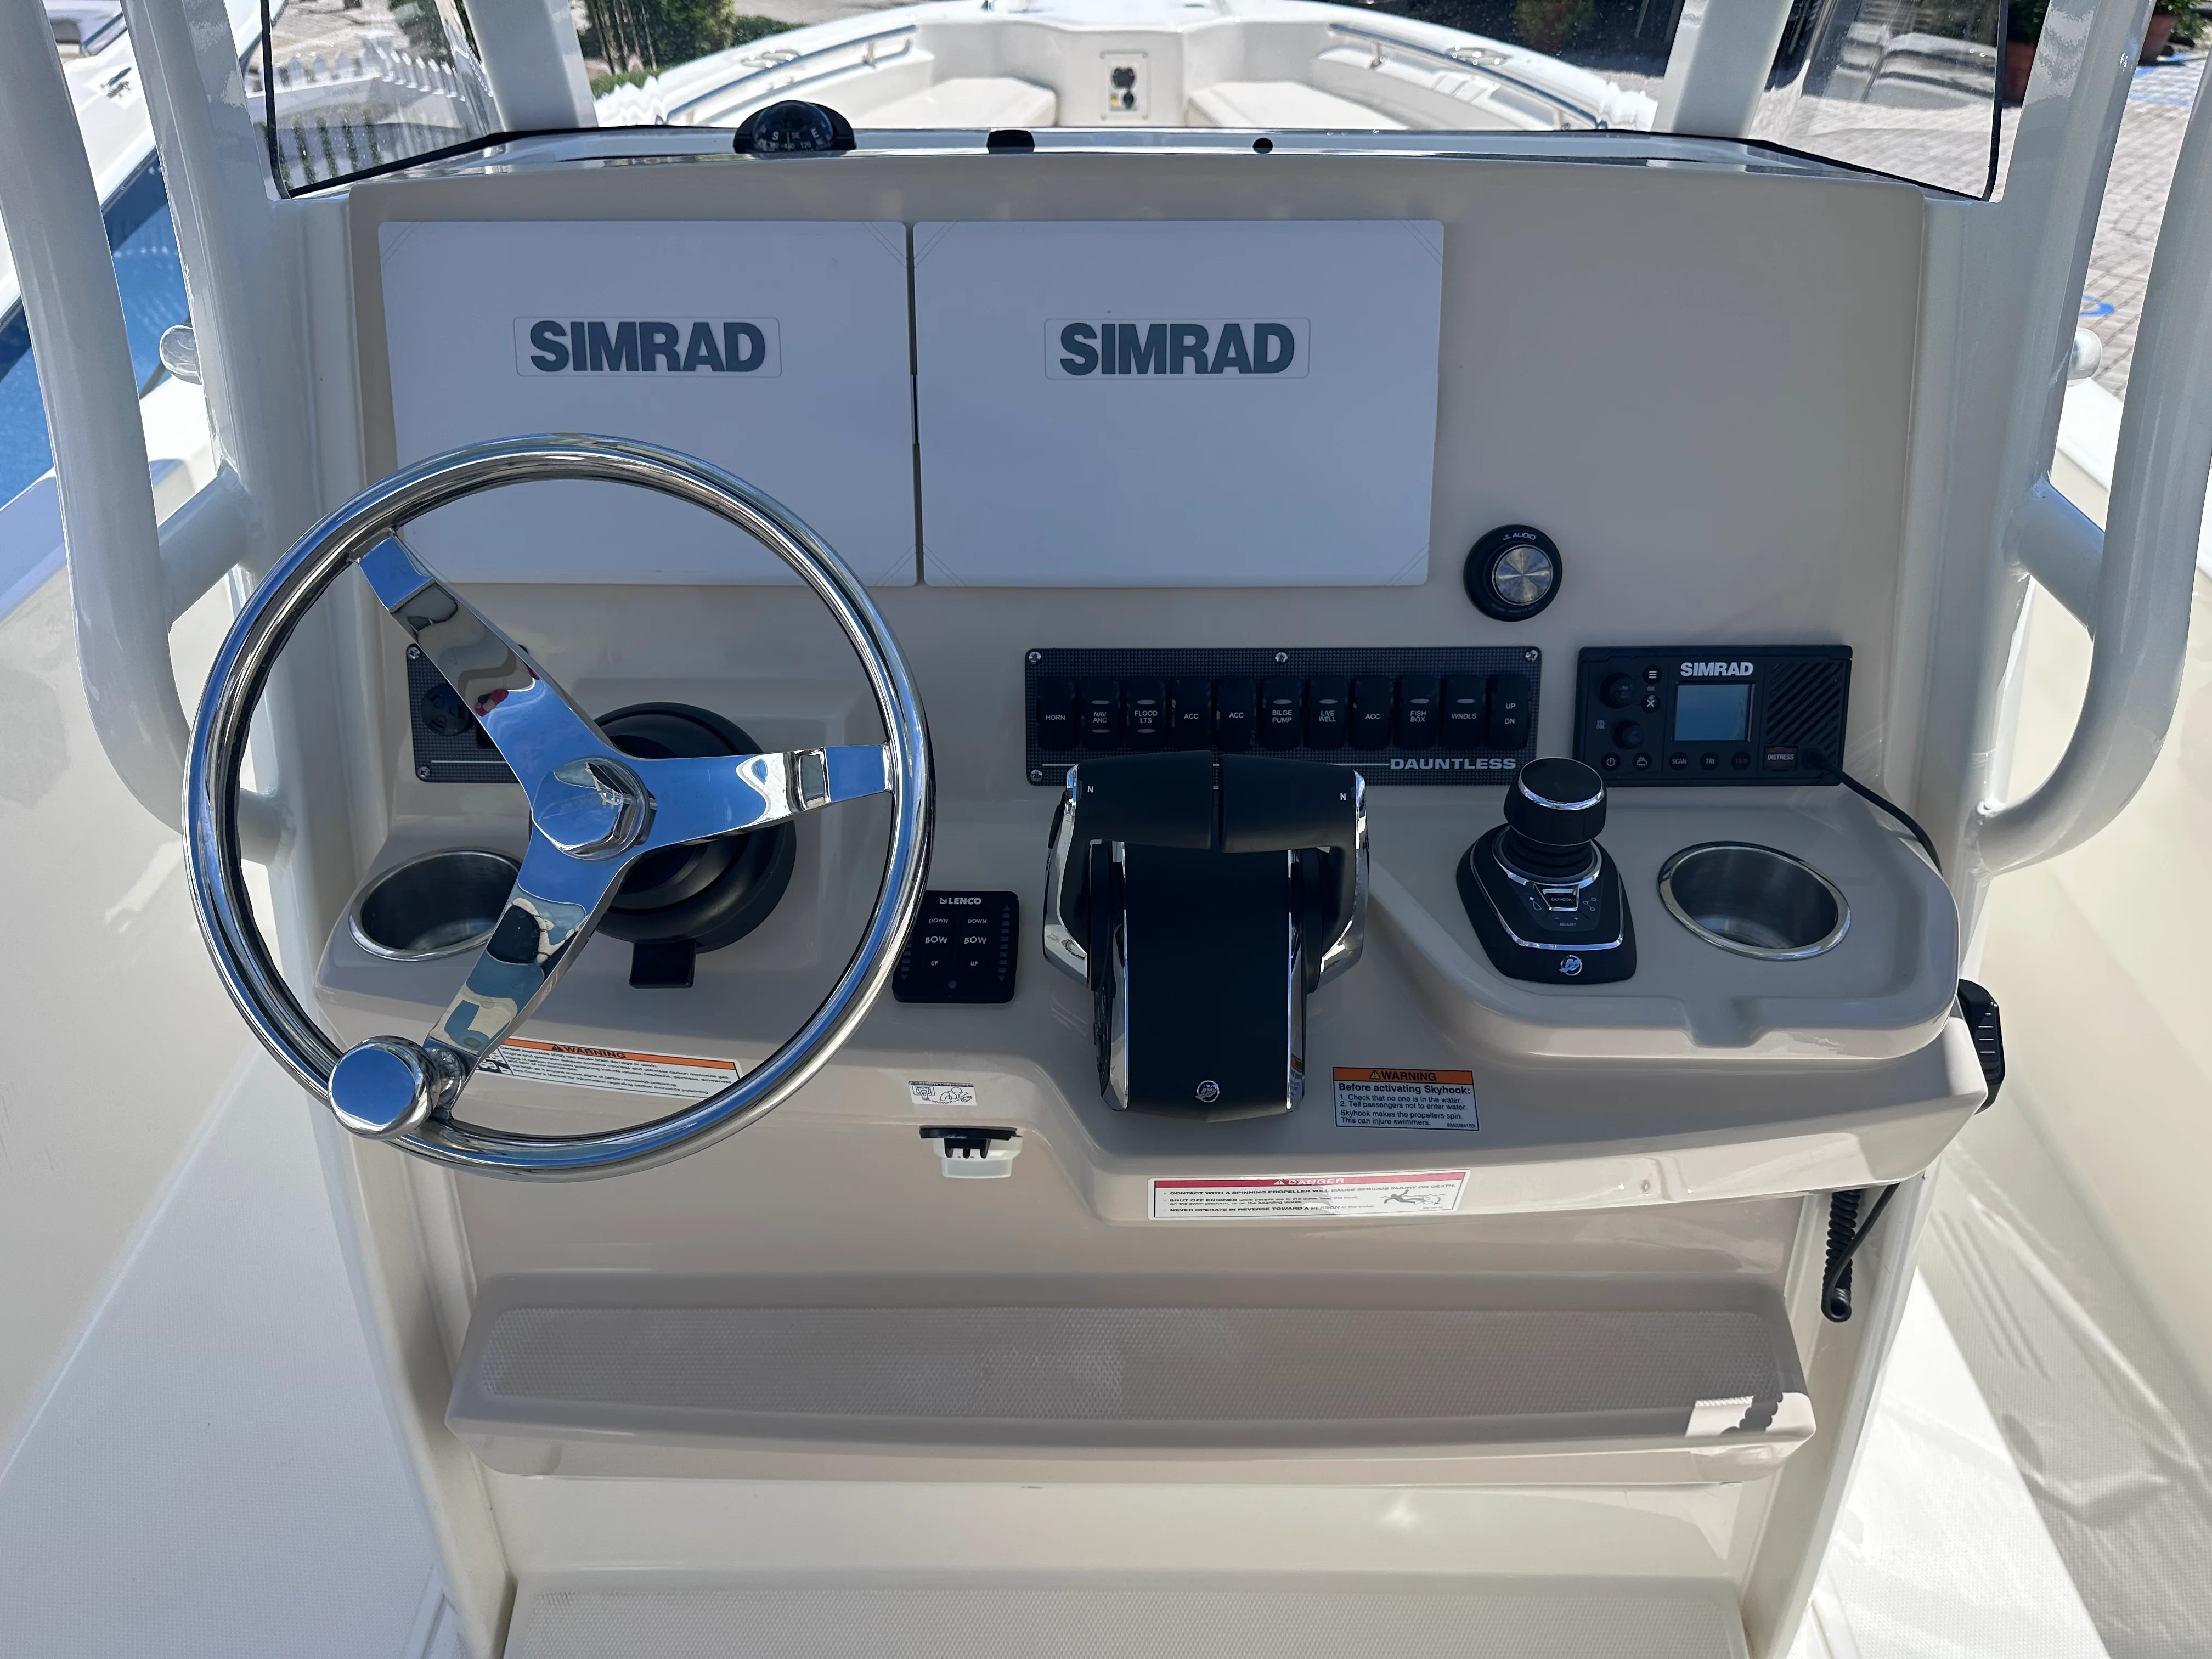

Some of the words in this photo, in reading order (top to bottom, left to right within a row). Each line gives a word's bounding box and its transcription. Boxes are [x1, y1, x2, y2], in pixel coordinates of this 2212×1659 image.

[772, 131, 779, 141] S
[810, 127, 820, 138] E
[529, 320, 765, 373] SIMRAD
[1059, 322, 1295, 376] SIMRAD
[1513, 532, 1536, 540] AUDIO
[1680, 662, 1753, 676] SIMRAD
[1390, 758, 1515, 770] DAUNTLESS
[924, 935, 948, 944] BOW
[565, 1047, 626, 1058] WARNING
[1382, 1071, 1437, 1081] WARNING
[1339, 1083, 1371, 1091] Before
[1374, 1084, 1421, 1094] activating
[1424, 1085, 1470, 1095] Skyhook:
[1341, 1110, 1370, 1118] Skyhook
